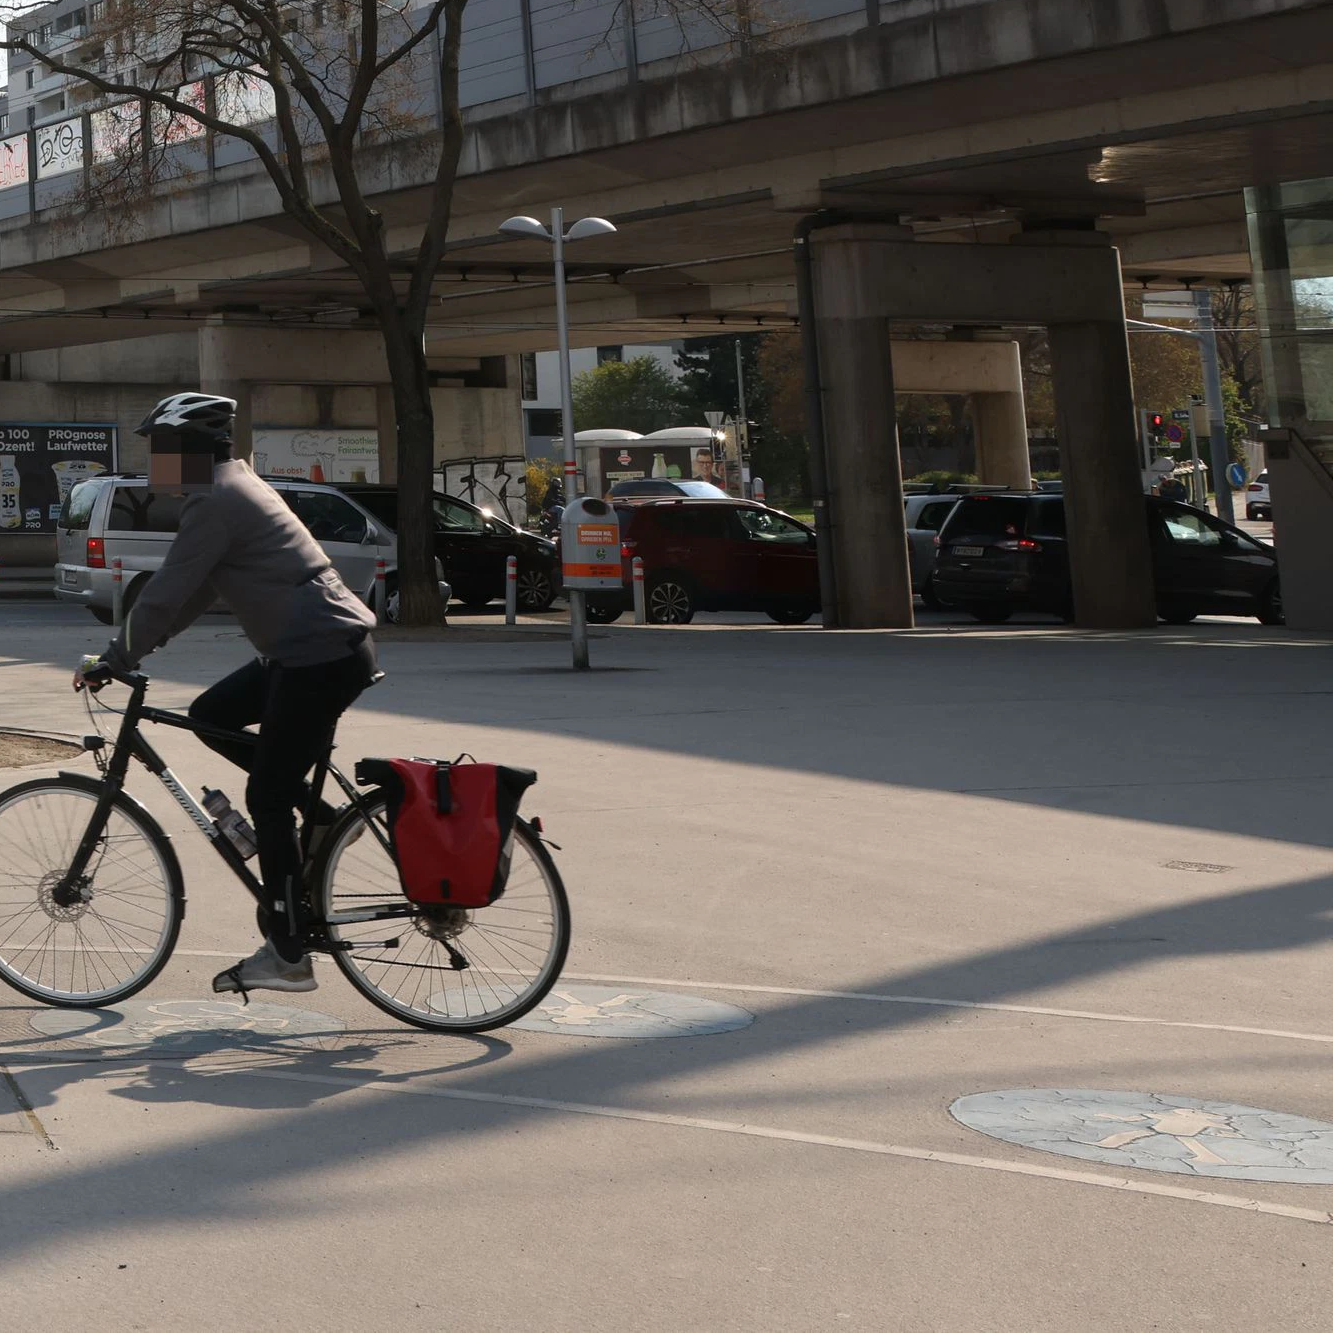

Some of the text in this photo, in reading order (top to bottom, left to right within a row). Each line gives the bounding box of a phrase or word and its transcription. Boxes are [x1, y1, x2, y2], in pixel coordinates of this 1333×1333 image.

[7, 429, 30, 439] 100
[48, 430, 106, 441] PROgnose
[46, 441, 108, 451] Laufwetter
[2, 494, 15, 508] 35
